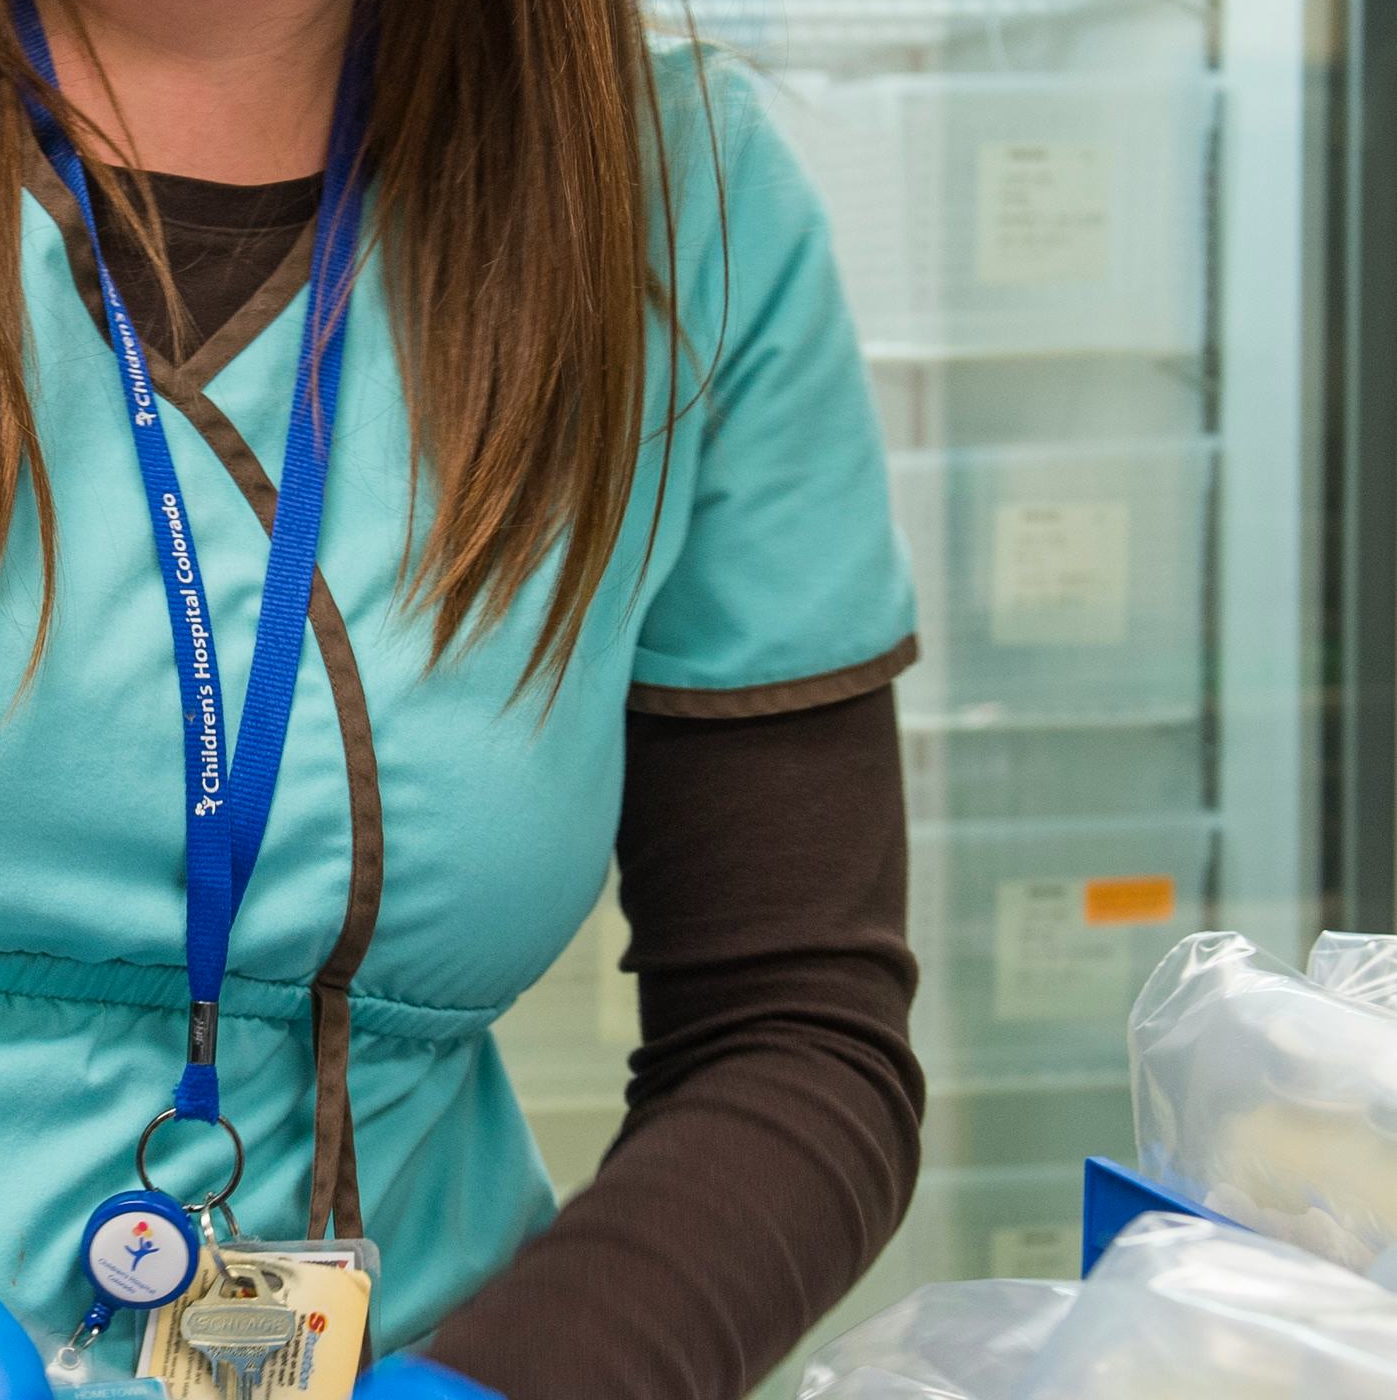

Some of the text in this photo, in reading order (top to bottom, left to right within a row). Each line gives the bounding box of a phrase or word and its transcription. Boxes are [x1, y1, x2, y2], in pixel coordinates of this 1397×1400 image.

[162, 493, 220, 794] Children's Hospital Colorado
